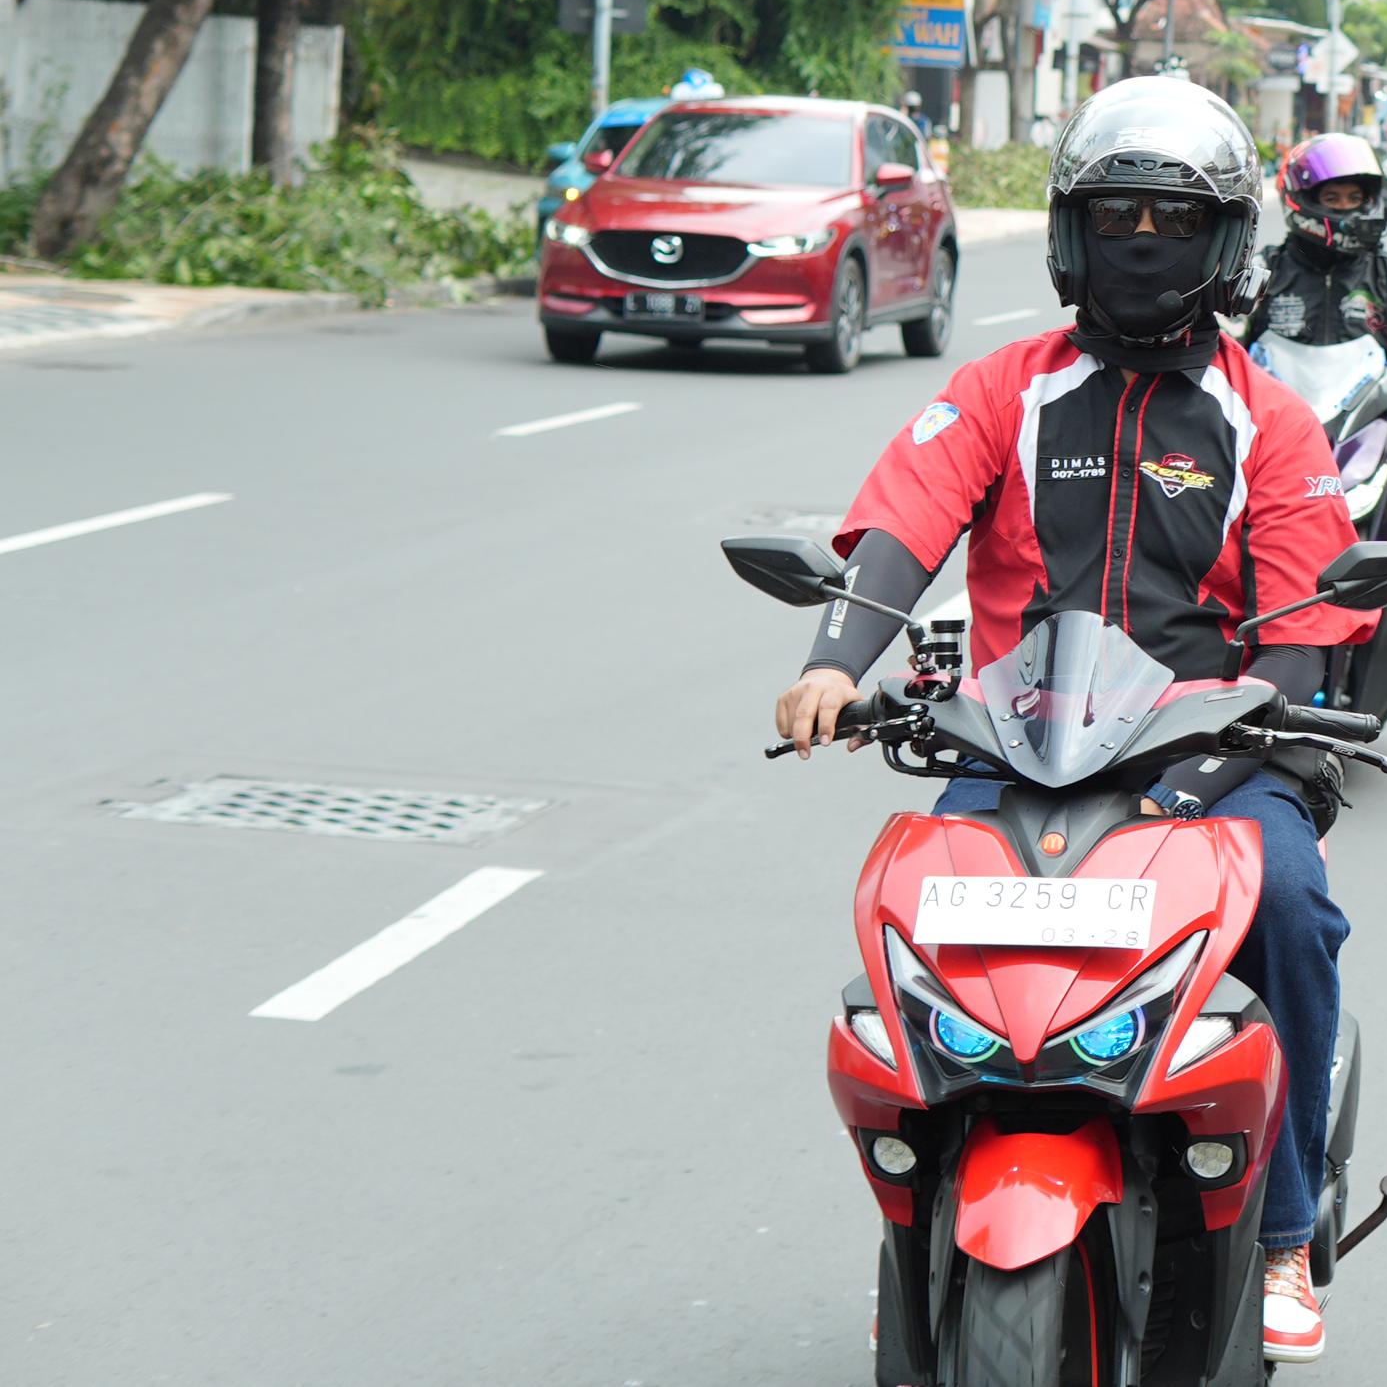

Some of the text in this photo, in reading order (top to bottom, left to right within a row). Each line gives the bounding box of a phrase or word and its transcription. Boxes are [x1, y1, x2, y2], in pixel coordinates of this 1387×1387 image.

[1051, 456, 1106, 469] DIMAS
[1051, 468, 1106, 479] 007-1789
[923, 881, 1148, 911] AG 3259 CR
